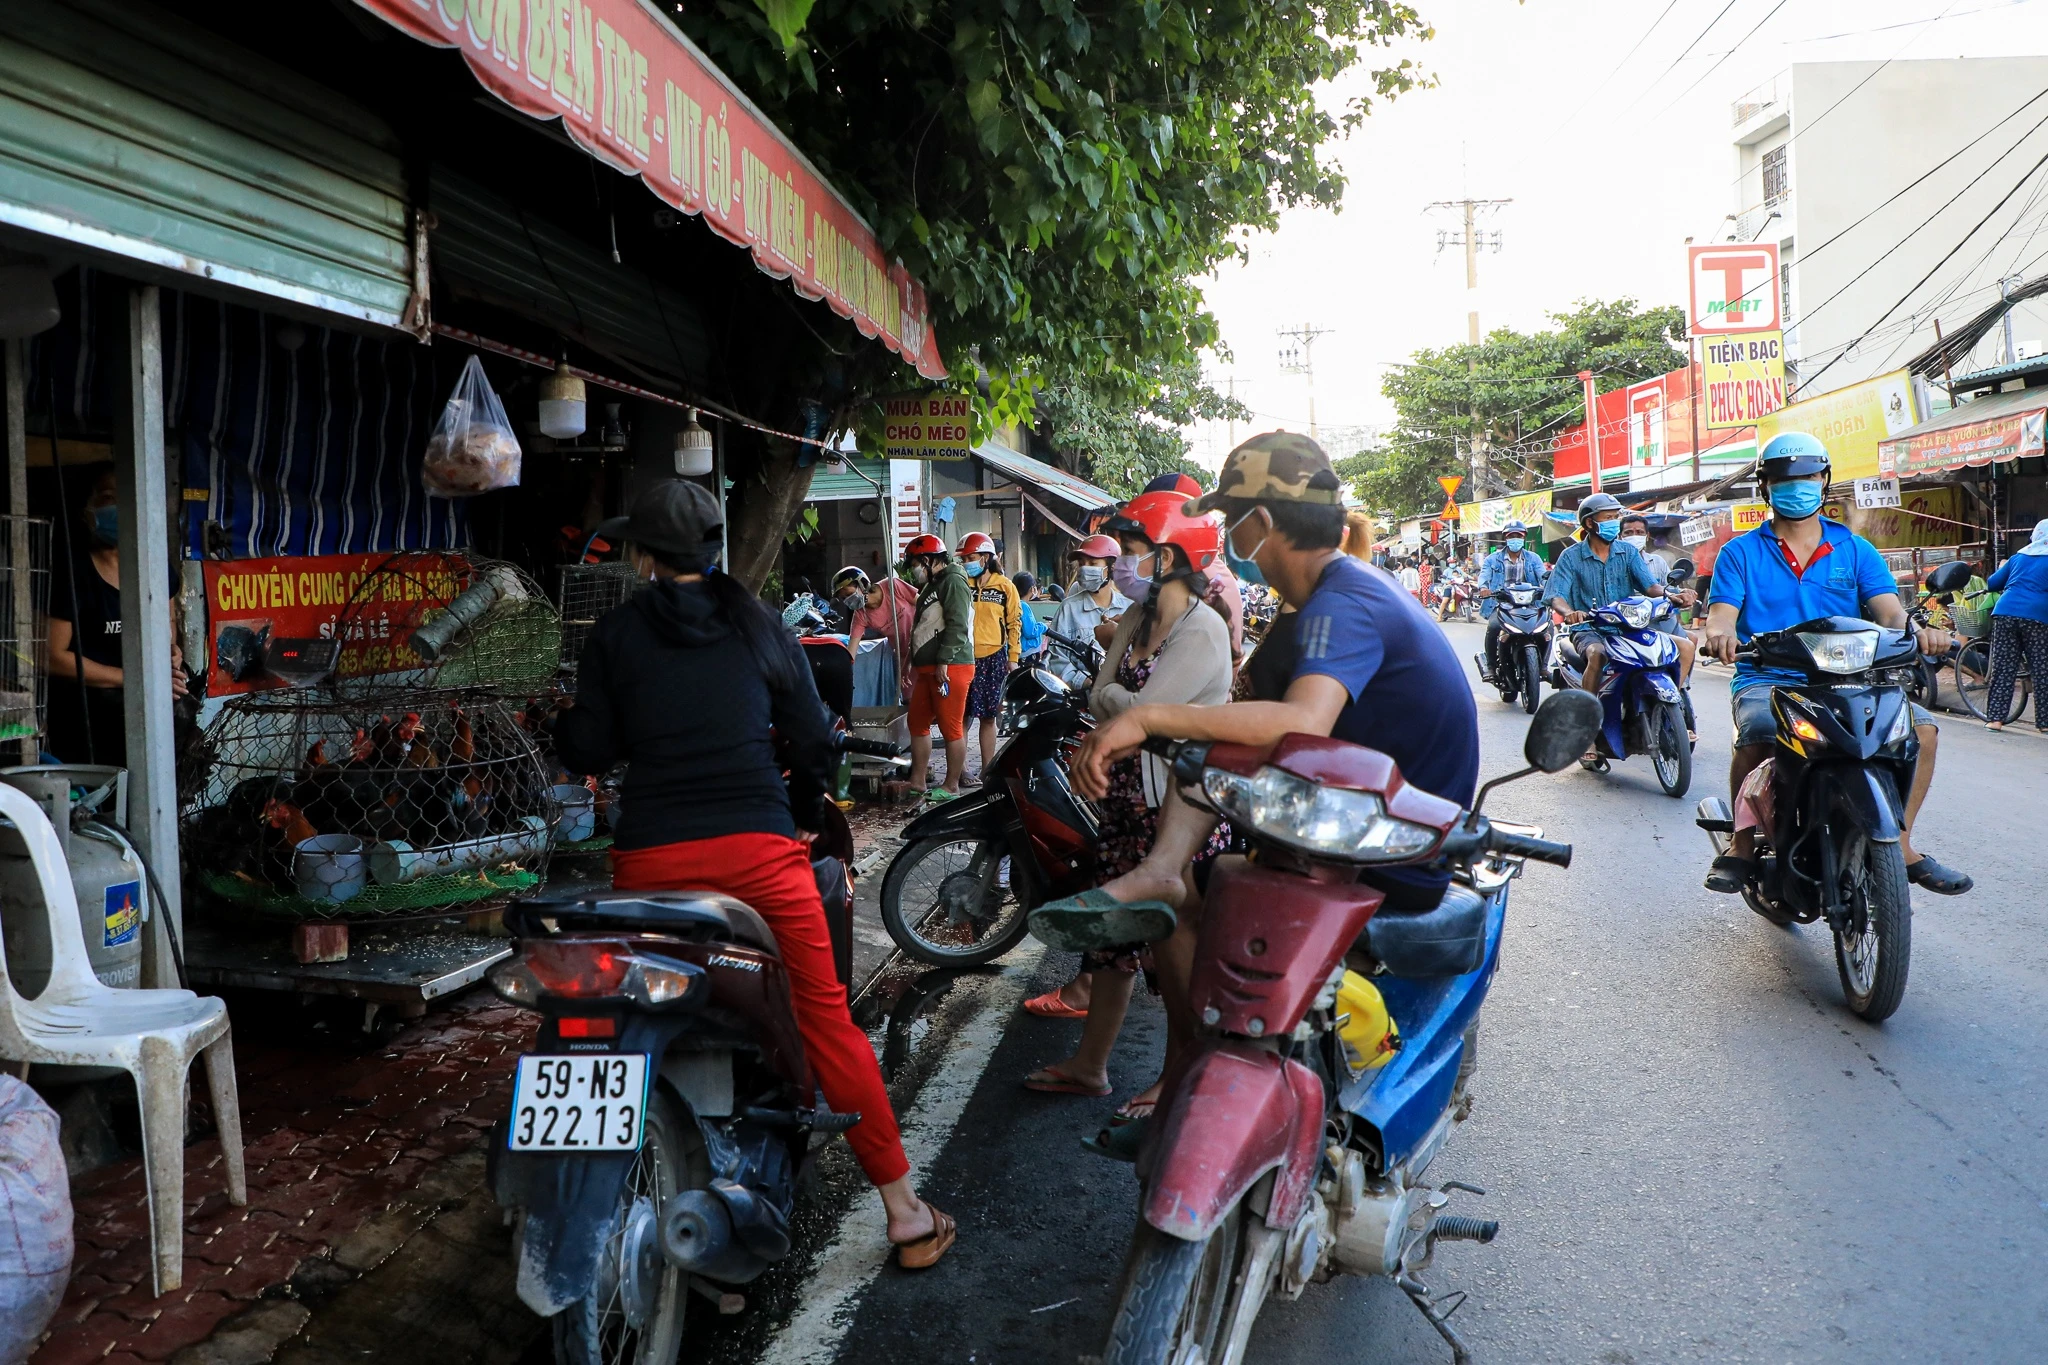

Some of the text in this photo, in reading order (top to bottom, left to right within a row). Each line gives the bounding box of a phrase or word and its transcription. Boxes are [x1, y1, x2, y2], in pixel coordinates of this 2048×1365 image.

[596, 17, 650, 163] TRE
[665, 78, 702, 210] VỊT
[705, 101, 731, 220] CỎ
[1707, 299, 1762, 313] MART
[1709, 339, 1779, 367] TIỆM BẠC
[1709, 369, 1743, 423] PHÚC
[1746, 367, 1783, 422] HOÀN
[886, 396, 967, 417] MUA BÁN
[886, 421, 967, 441] CHÓ MÈO
[2000, 419, 2020, 432] TRE
[887, 445, 967, 459] NHẬN LÀM CÔNG
[1636, 442, 1660, 460] MART
[1780, 447, 1804, 455] CLEAR
[1877, 496, 1900, 506] TAI
[1737, 507, 1766, 523] TIỆM
[217, 565, 295, 612] CHUYÊN
[299, 572, 345, 606] CUNG
[348, 558, 379, 604] CẤP
[382, 571, 402, 602] BA
[369, 611, 390, 639] LẺ
[707, 952, 763, 974] VISION
[517, 1105, 636, 1147] 322.13
